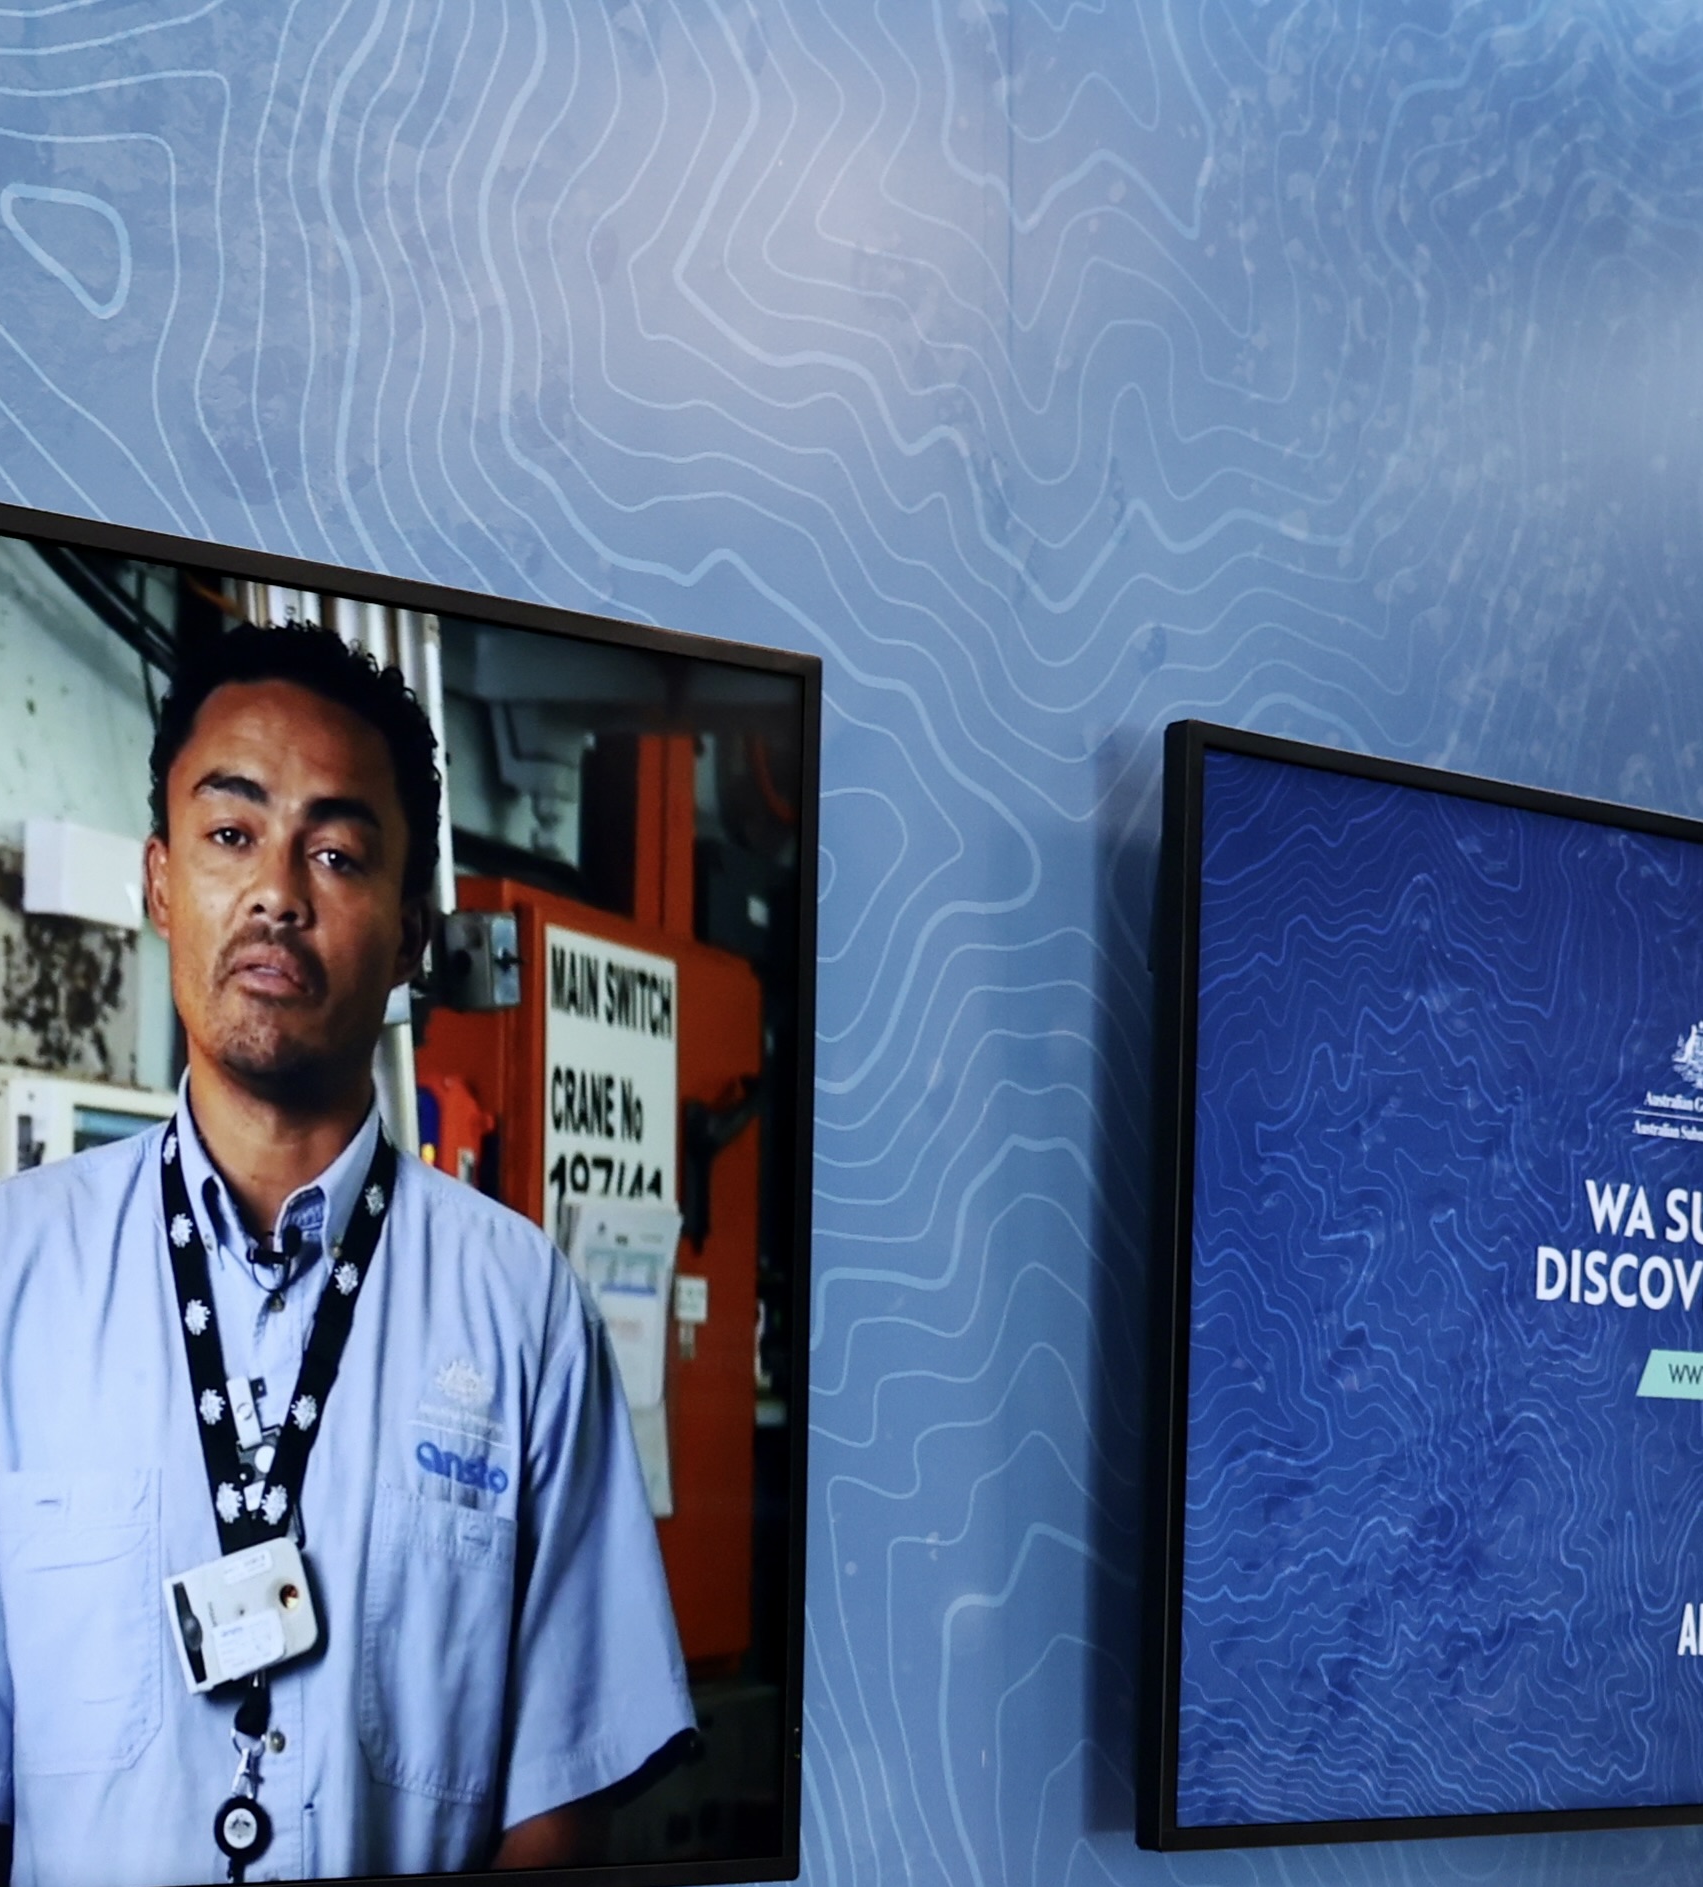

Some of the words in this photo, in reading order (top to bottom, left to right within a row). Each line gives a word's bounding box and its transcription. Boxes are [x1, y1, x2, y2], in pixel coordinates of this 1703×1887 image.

[551, 944, 598, 1021] MAIN
[605, 957, 671, 1039] SWITCH
[551, 1065, 614, 1138] CRANE
[621, 1076, 643, 1143] No
[1632, 1119, 1680, 1138] Australian
[1643, 1090, 1694, 1112] Australian
[1585, 1179, 1655, 1240] WA
